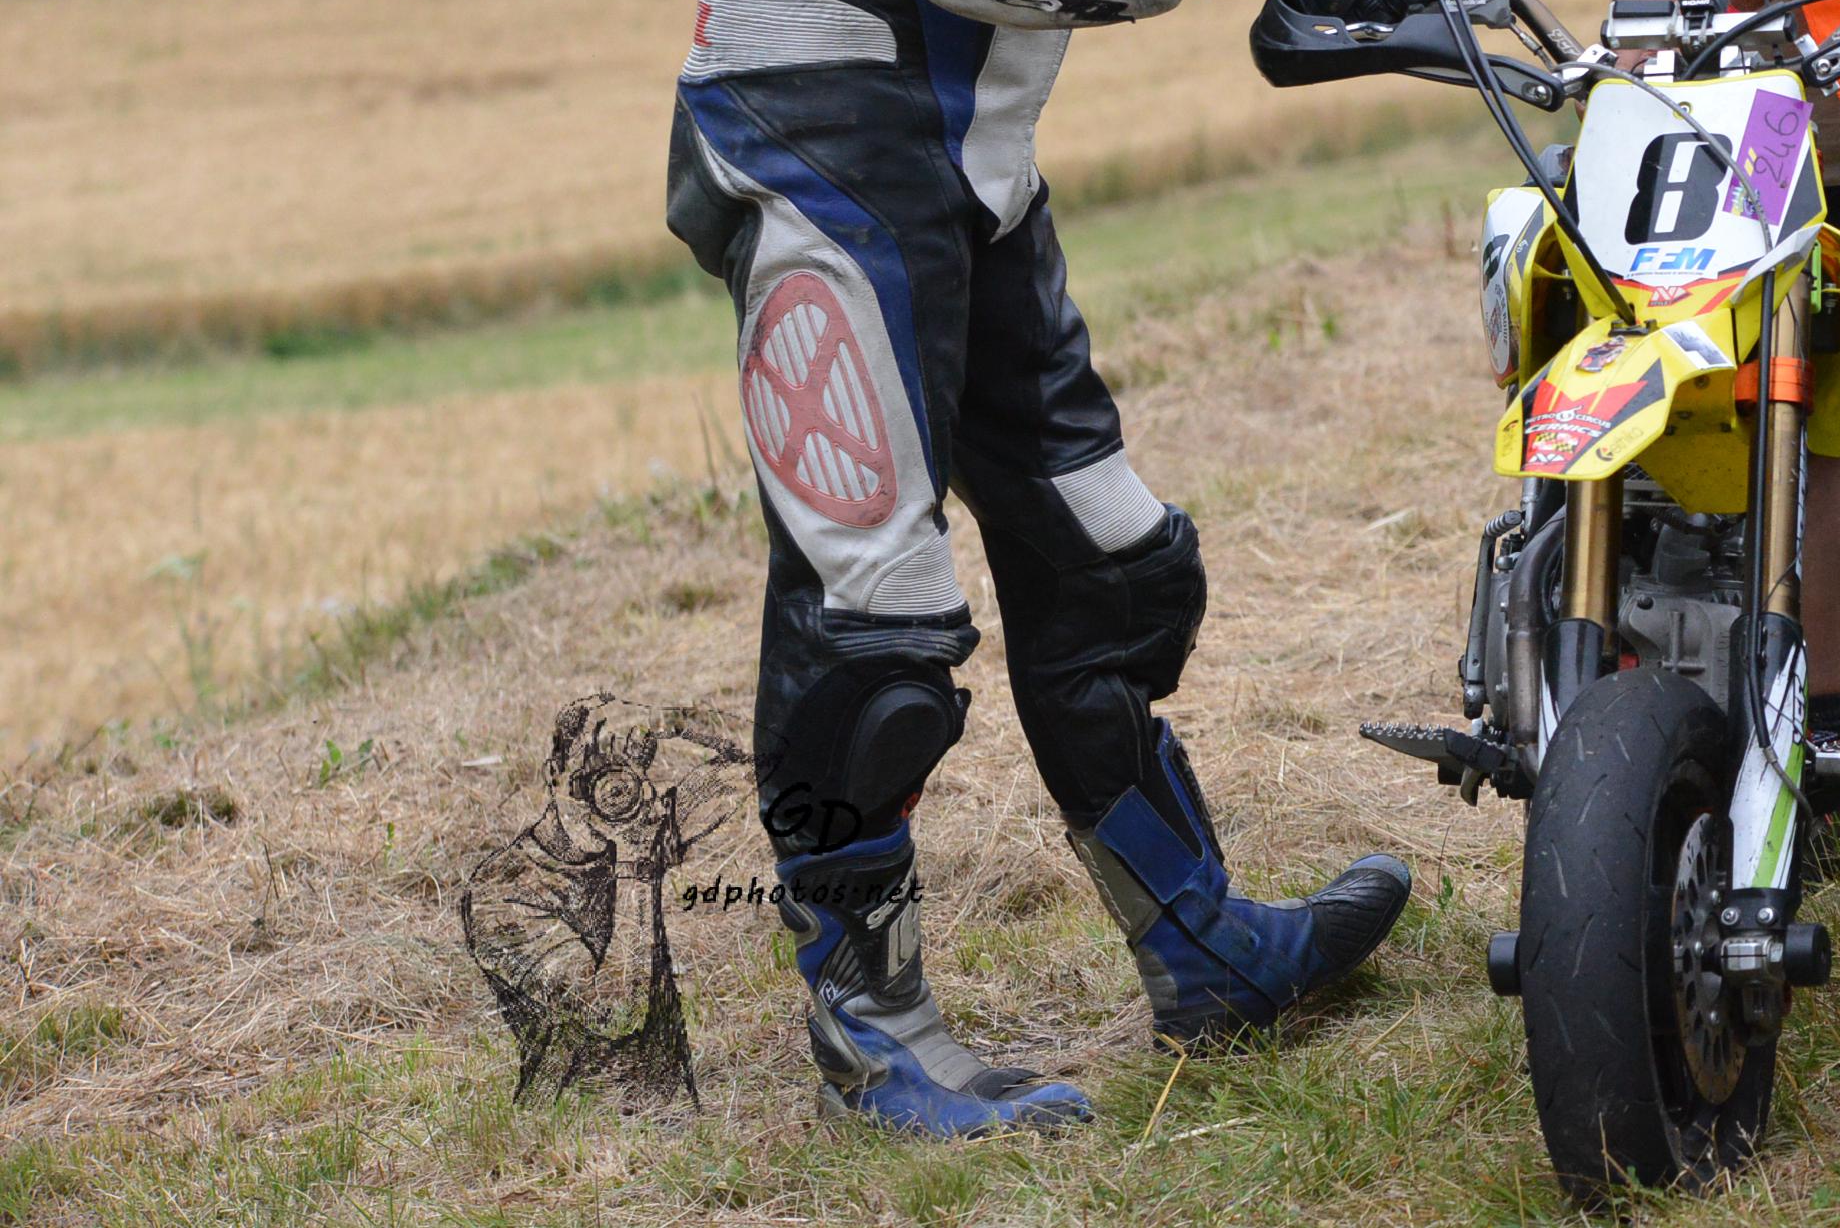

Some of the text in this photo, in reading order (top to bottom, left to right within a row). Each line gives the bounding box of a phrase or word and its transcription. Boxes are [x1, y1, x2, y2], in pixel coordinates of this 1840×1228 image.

[1753, 111, 1800, 186] 246
[1625, 132, 1733, 245] 8
[1575, 414, 1612, 429] CIRCUS
